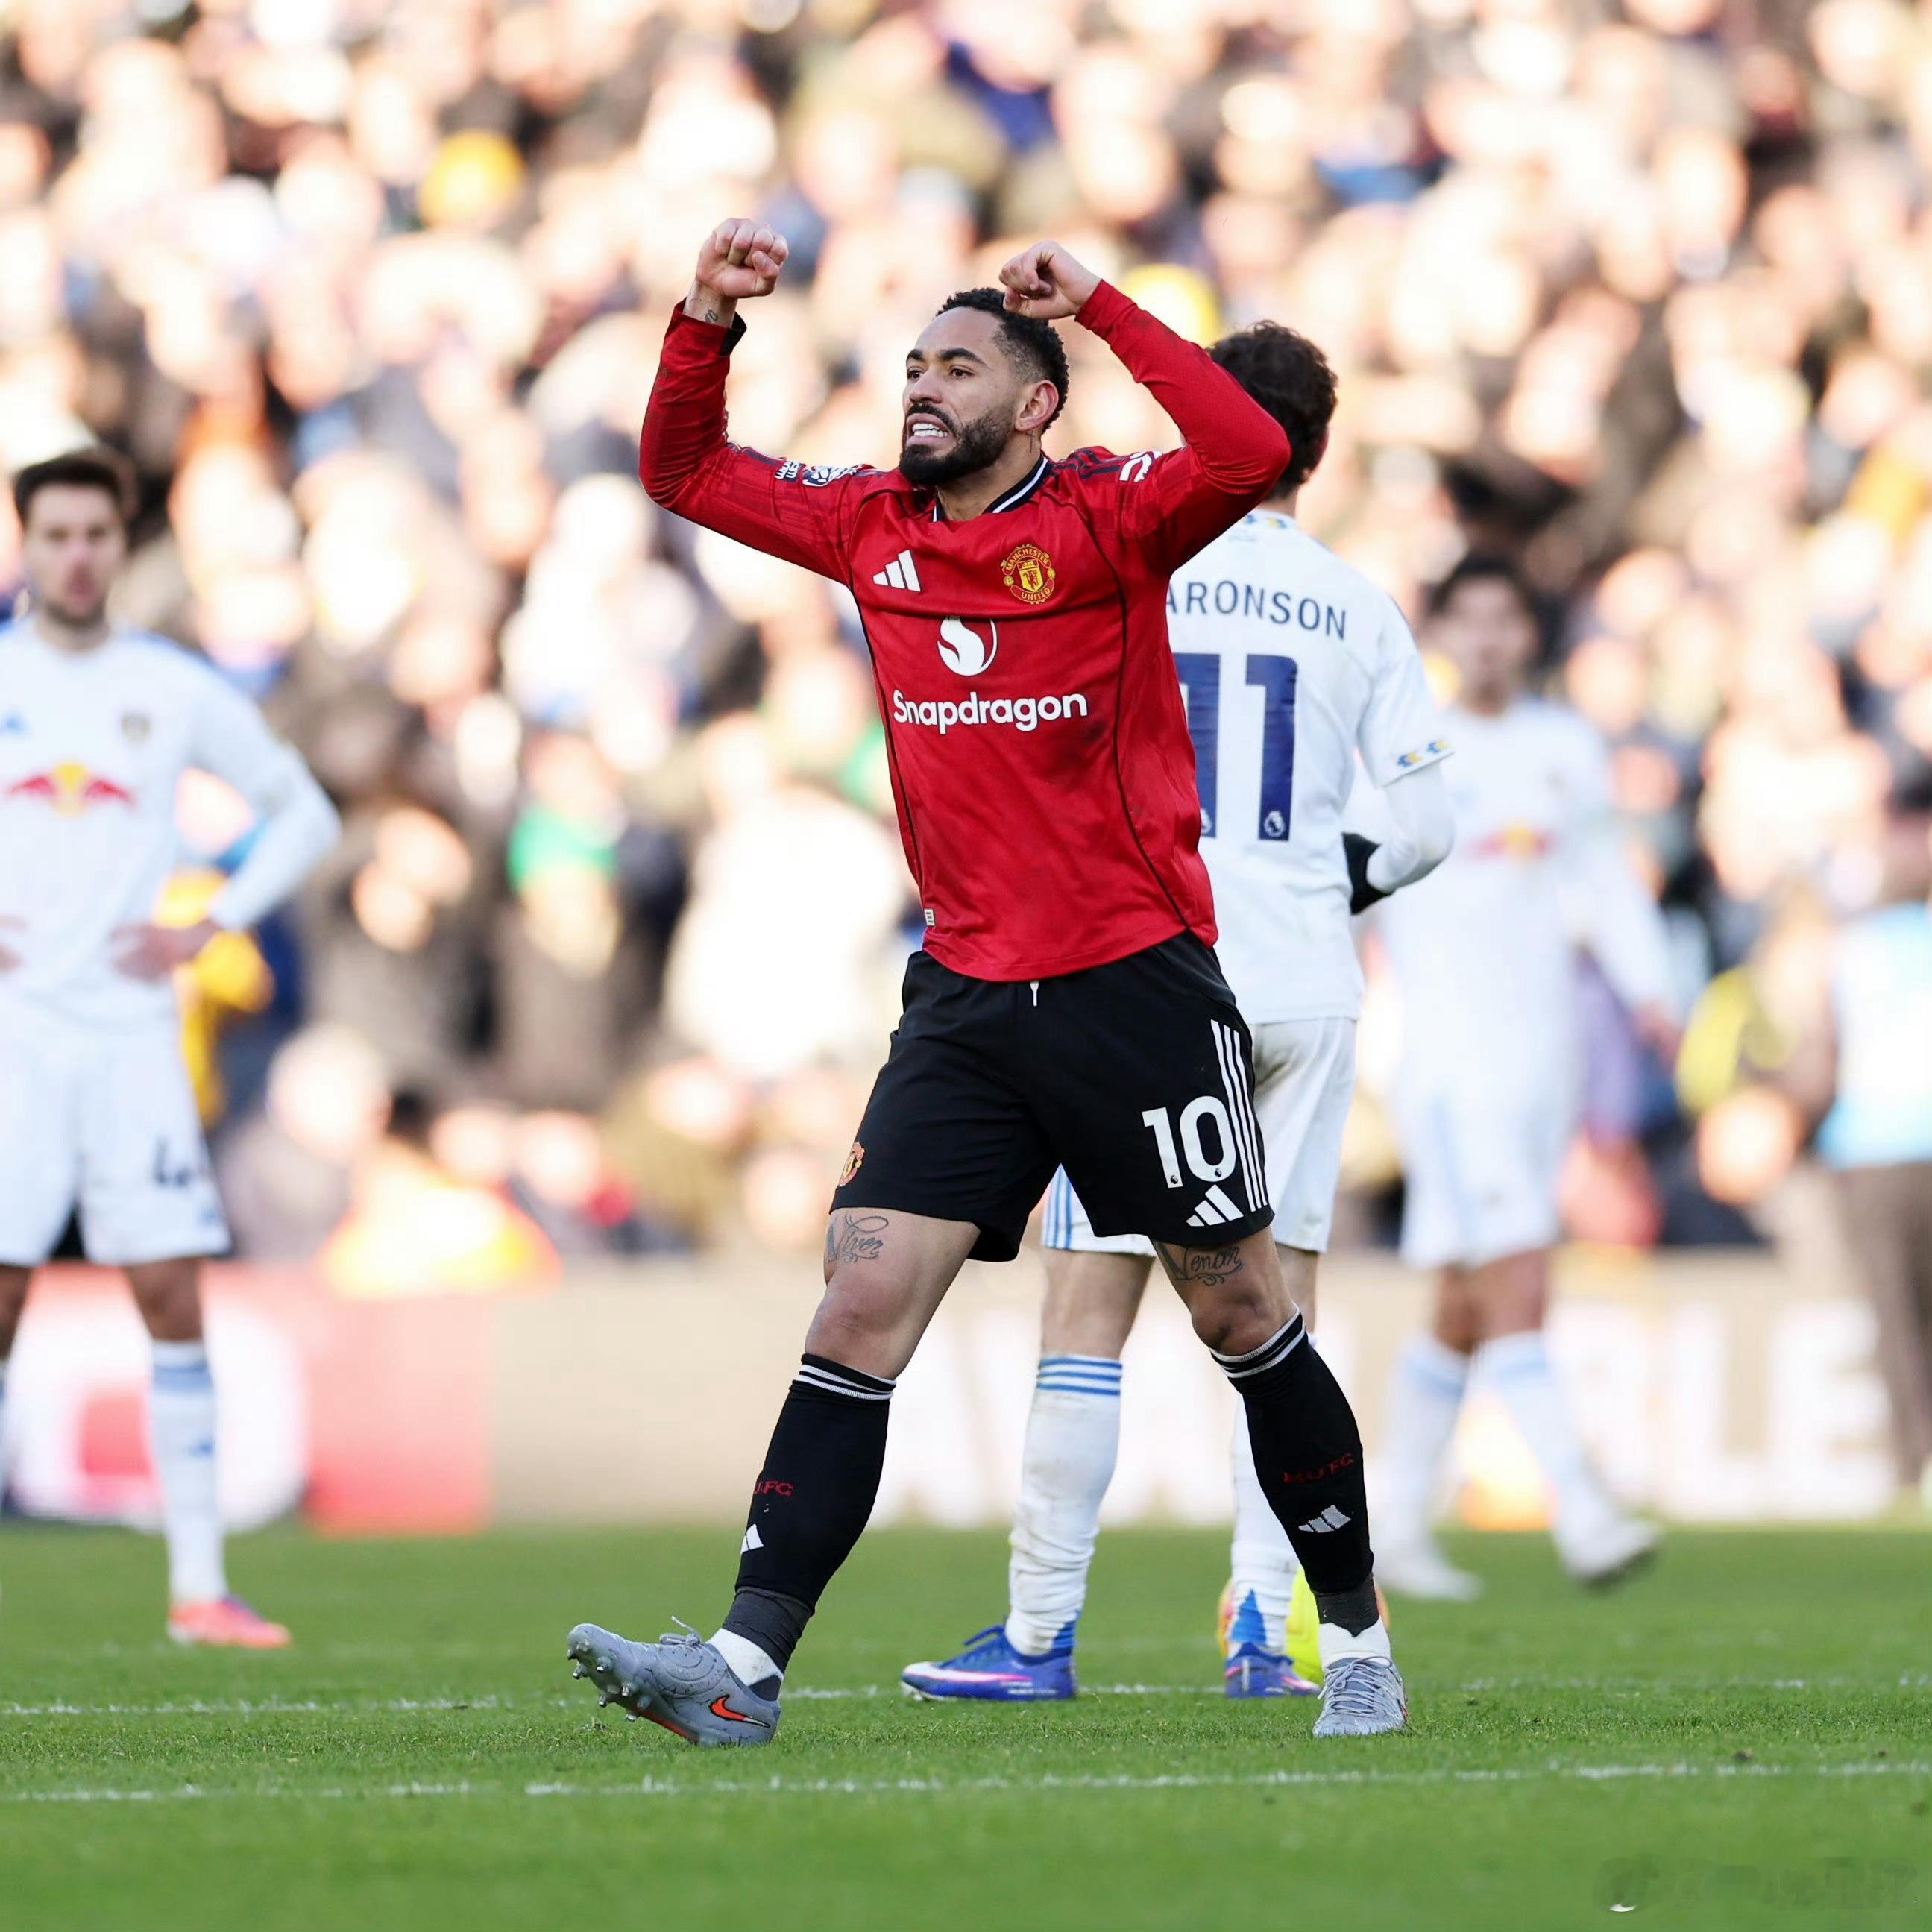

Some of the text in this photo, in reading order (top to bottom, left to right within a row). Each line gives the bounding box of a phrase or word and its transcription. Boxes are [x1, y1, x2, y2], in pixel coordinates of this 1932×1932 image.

[1006, 548, 1049, 572] MANCHESTER
[1021, 587, 1051, 601] UNITED
[893, 689, 1088, 734] Snapdragon
[1171, 652, 1298, 841] 11
[1142, 1095, 1237, 1188] 10
